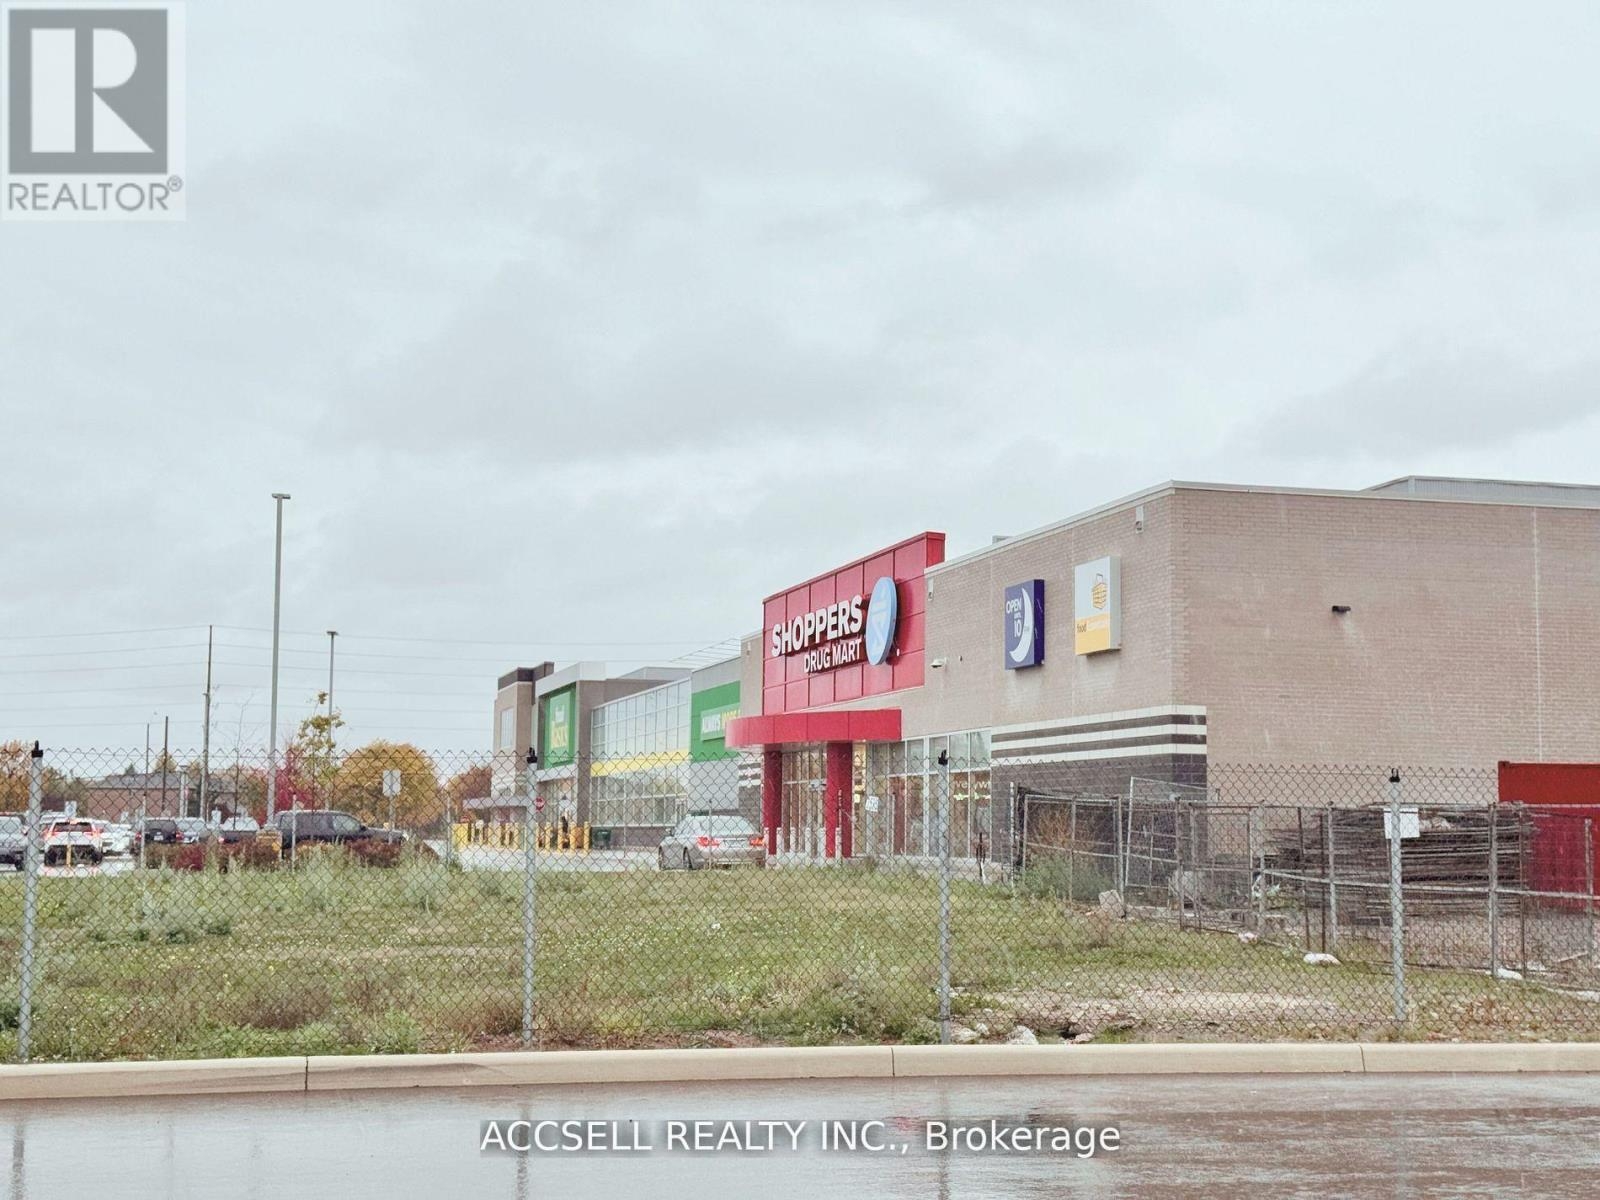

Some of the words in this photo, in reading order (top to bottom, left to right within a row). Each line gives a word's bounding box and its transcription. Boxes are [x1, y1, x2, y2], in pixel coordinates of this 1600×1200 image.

[1006, 597, 1022, 614] OPEN
[771, 594, 863, 658] SHOPPERS
[1014, 619, 1022, 638] 10
[803, 649, 831, 674] DRUG
[832, 638, 863, 667] MART
